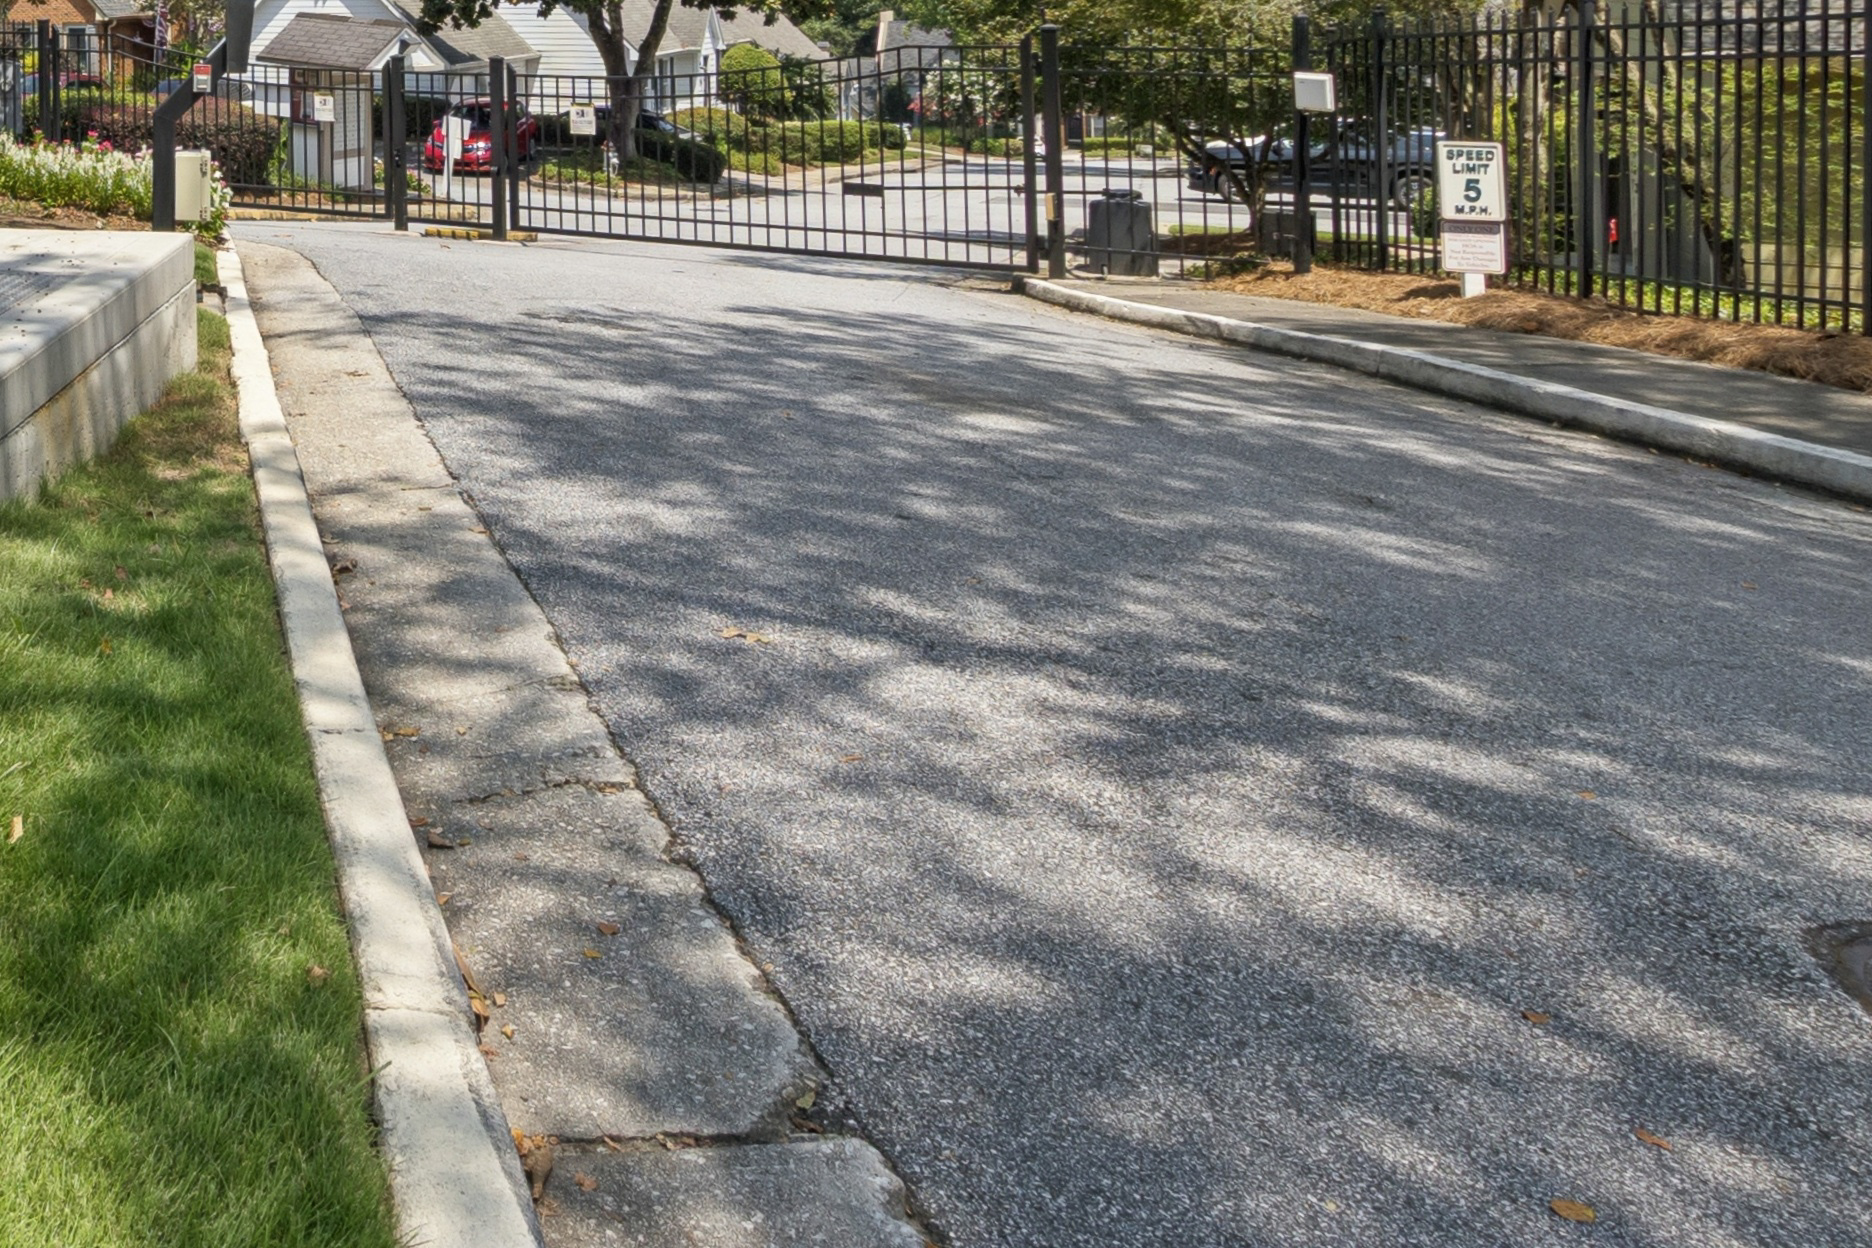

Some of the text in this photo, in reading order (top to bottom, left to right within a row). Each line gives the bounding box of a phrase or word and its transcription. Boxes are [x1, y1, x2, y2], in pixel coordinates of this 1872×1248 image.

[1446, 149, 1494, 161] SPEED
[1452, 163, 1490, 175] LIMIT
[1463, 178, 1482, 203] 5
[1454, 205, 1492, 216] M.P.H.
